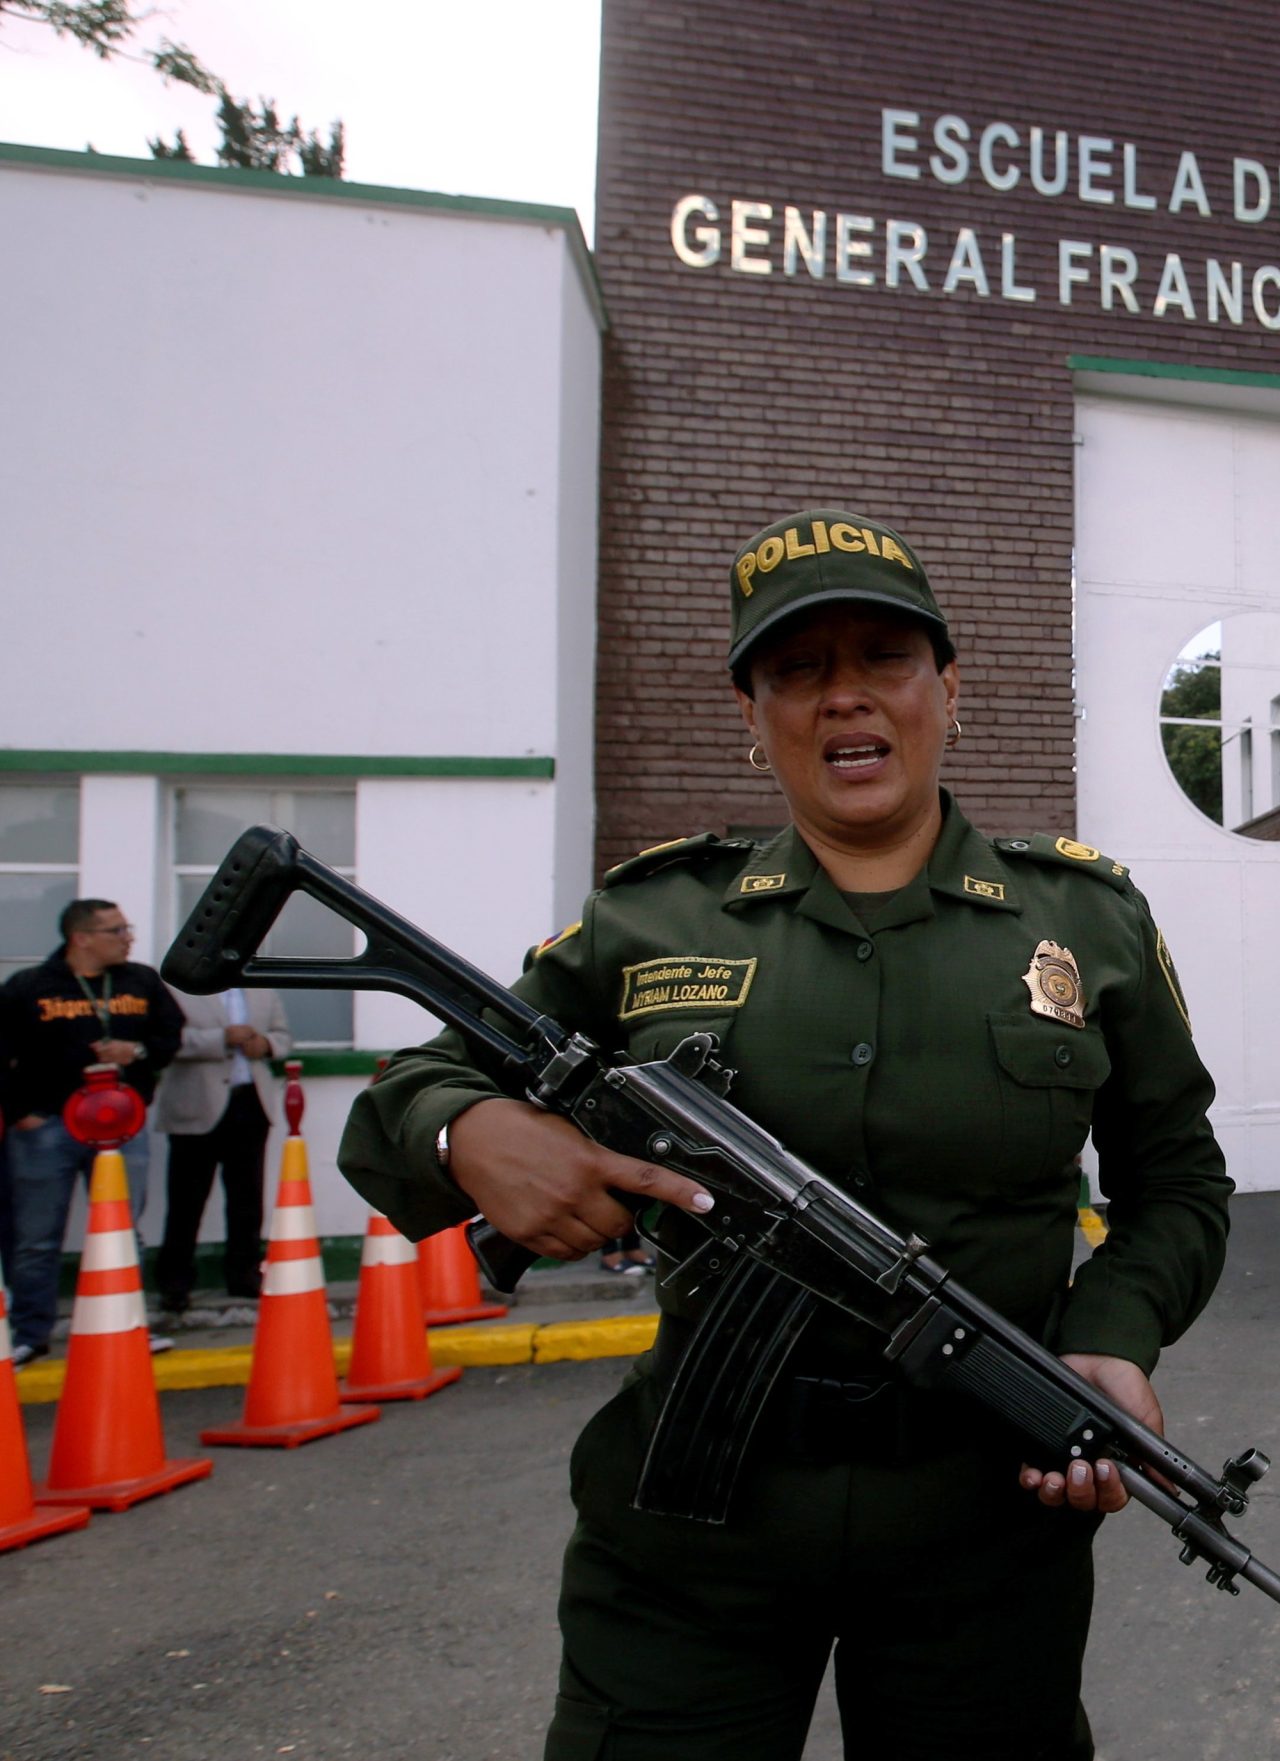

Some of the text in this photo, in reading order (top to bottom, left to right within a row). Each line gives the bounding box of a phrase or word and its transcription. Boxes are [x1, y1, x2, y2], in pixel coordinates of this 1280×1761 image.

[882, 108, 1211, 217] ESCUELA
[671, 195, 1036, 302] GENERAL
[736, 521, 913, 597] POLICIA
[672, 984, 728, 1001] LOZANO
[698, 966, 732, 980] Jefe
